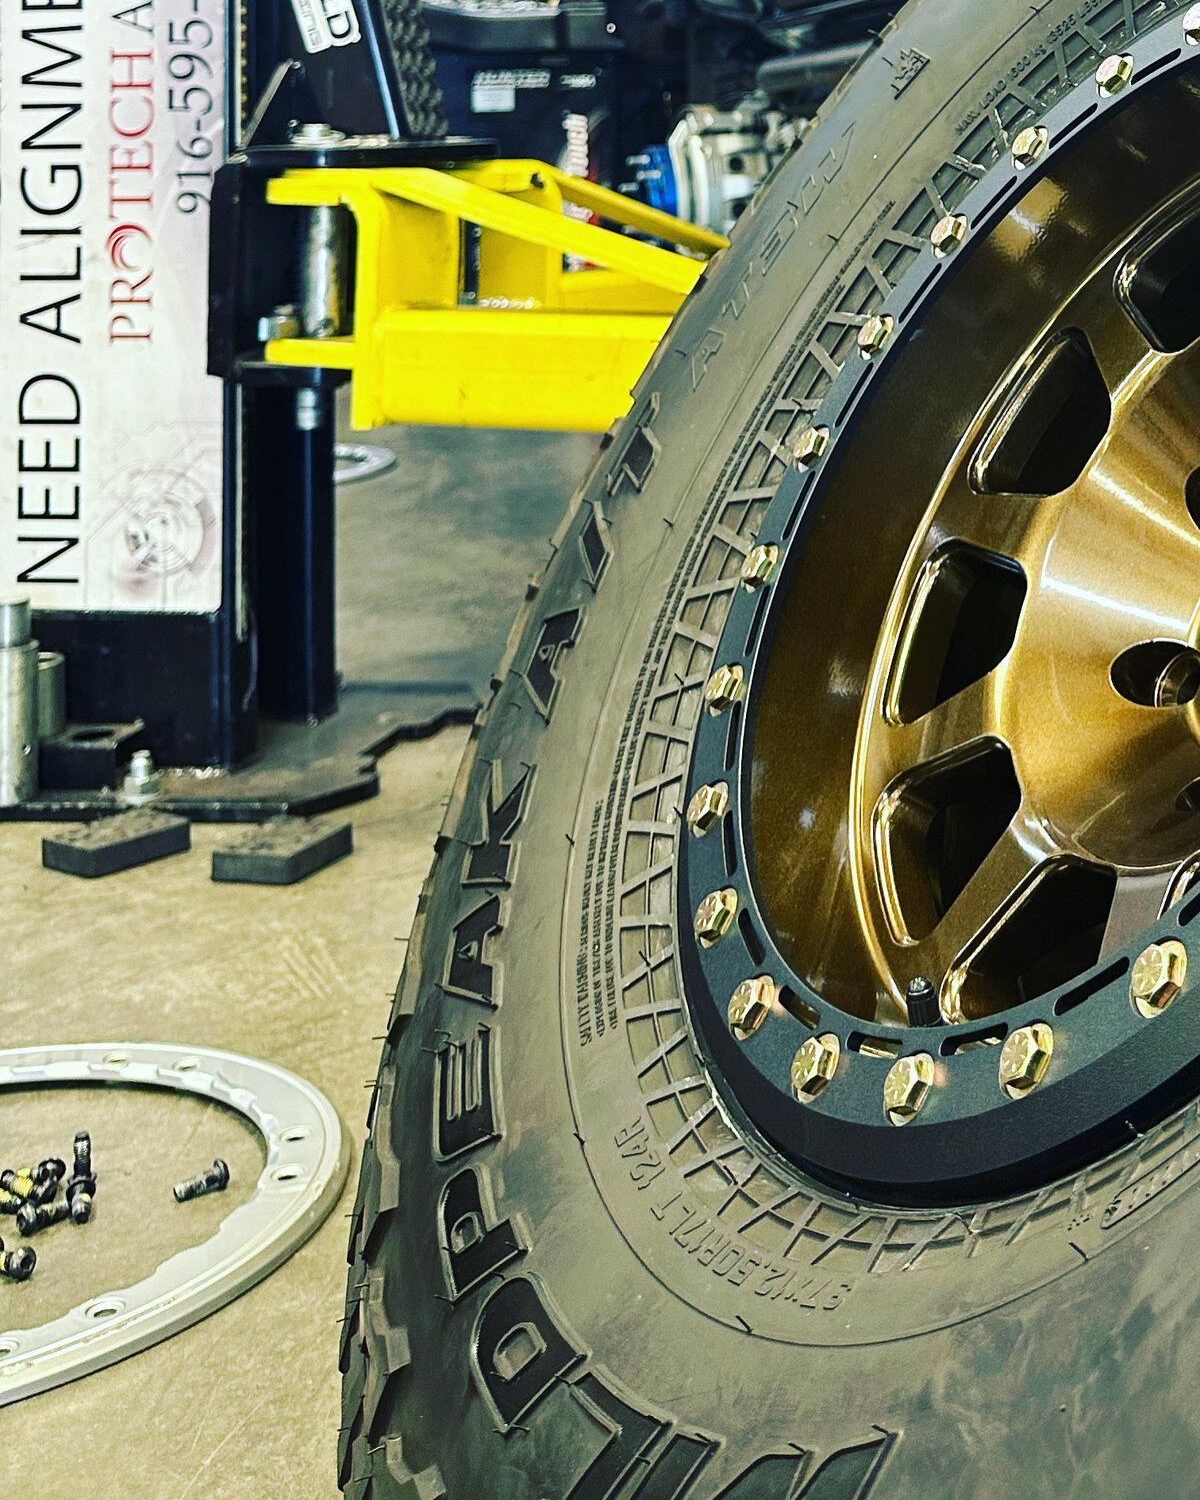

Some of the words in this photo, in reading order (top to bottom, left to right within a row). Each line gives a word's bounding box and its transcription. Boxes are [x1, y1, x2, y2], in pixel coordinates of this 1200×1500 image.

[108, 48, 154, 346] PROTECH
[981, 77, 1007, 110] LOAD
[17, 373, 82, 583] NEED
